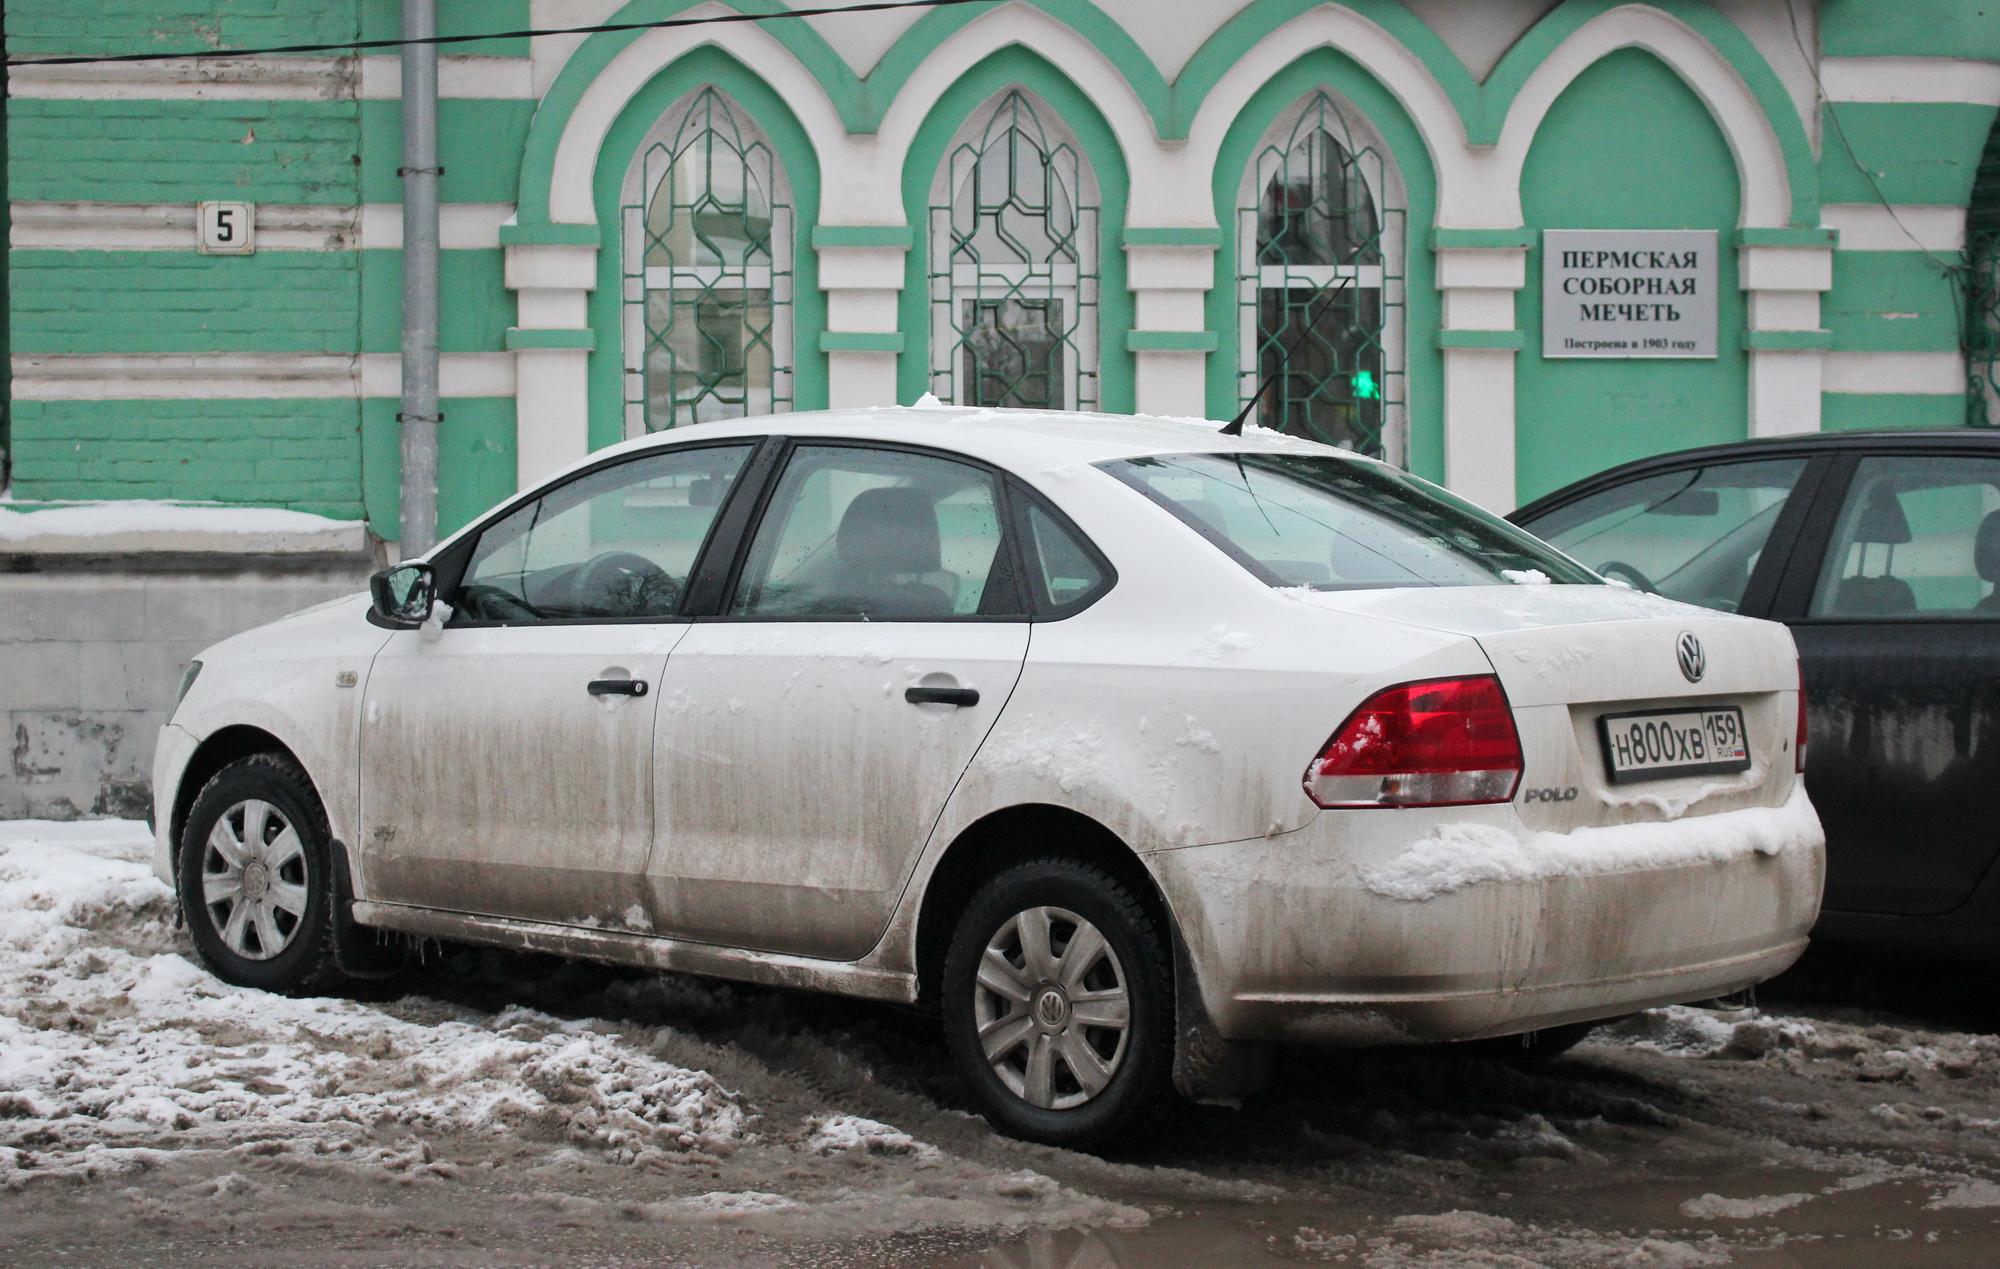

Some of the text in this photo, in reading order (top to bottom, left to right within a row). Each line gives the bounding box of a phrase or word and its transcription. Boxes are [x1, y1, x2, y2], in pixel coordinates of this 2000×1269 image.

[217, 210, 233, 242] 5
[1562, 251, 1698, 269] ПЕРМСКАЯ
[1563, 277, 1697, 295] СОБОРНАЯ
[1579, 303, 1681, 321] МЕЧЕТЬ
[1564, 338, 1697, 351] Построена в 1903 году
[1706, 713, 1737, 746] 159
[1718, 747, 1734, 758] RUS
[1524, 786, 1578, 803] POLO
